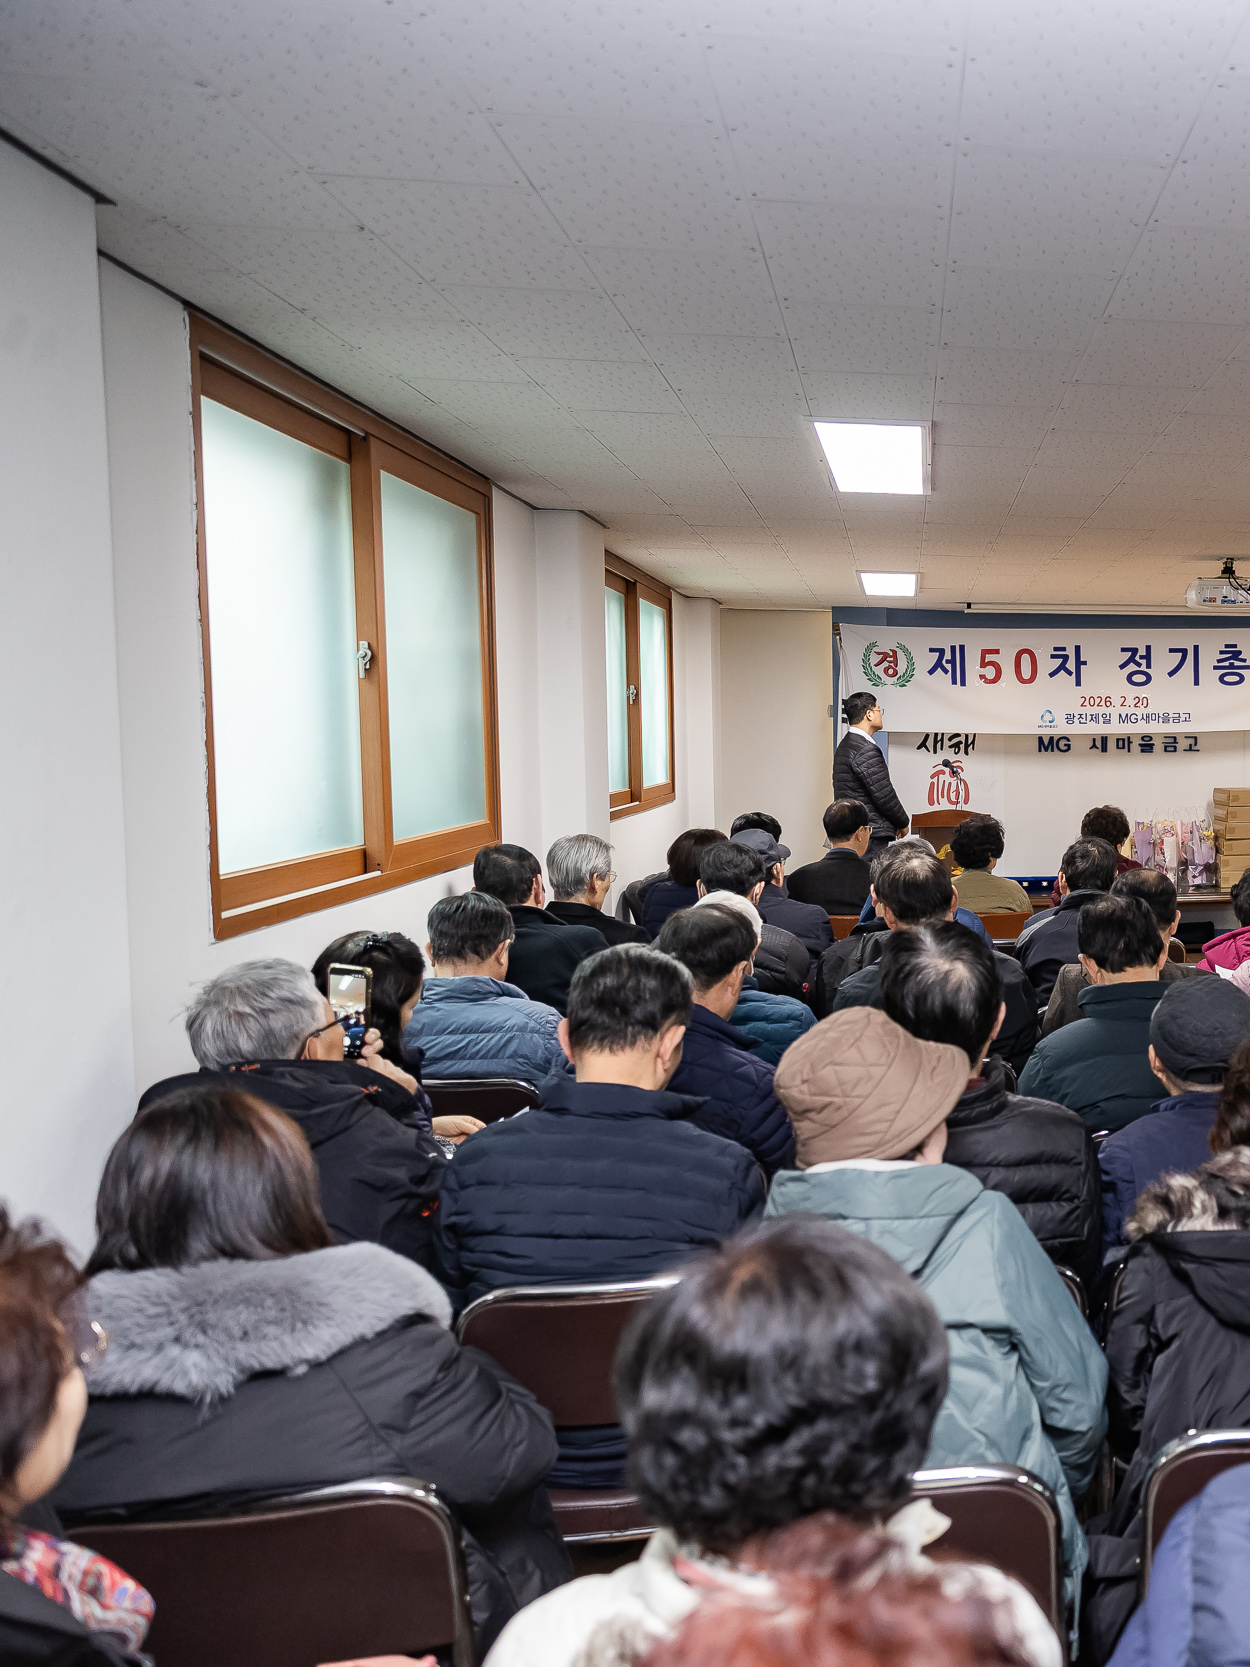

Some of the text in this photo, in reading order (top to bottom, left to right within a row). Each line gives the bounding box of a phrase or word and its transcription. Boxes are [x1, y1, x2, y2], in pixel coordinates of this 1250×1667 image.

[873, 648, 899, 678] 경
[926, 643, 1088, 688] 제50차
[1064, 711, 1192, 725] 광진제일 MG새마을금고
[916, 732, 977, 756] 새해
[1037, 735, 1200, 753] MG 새마을금고
